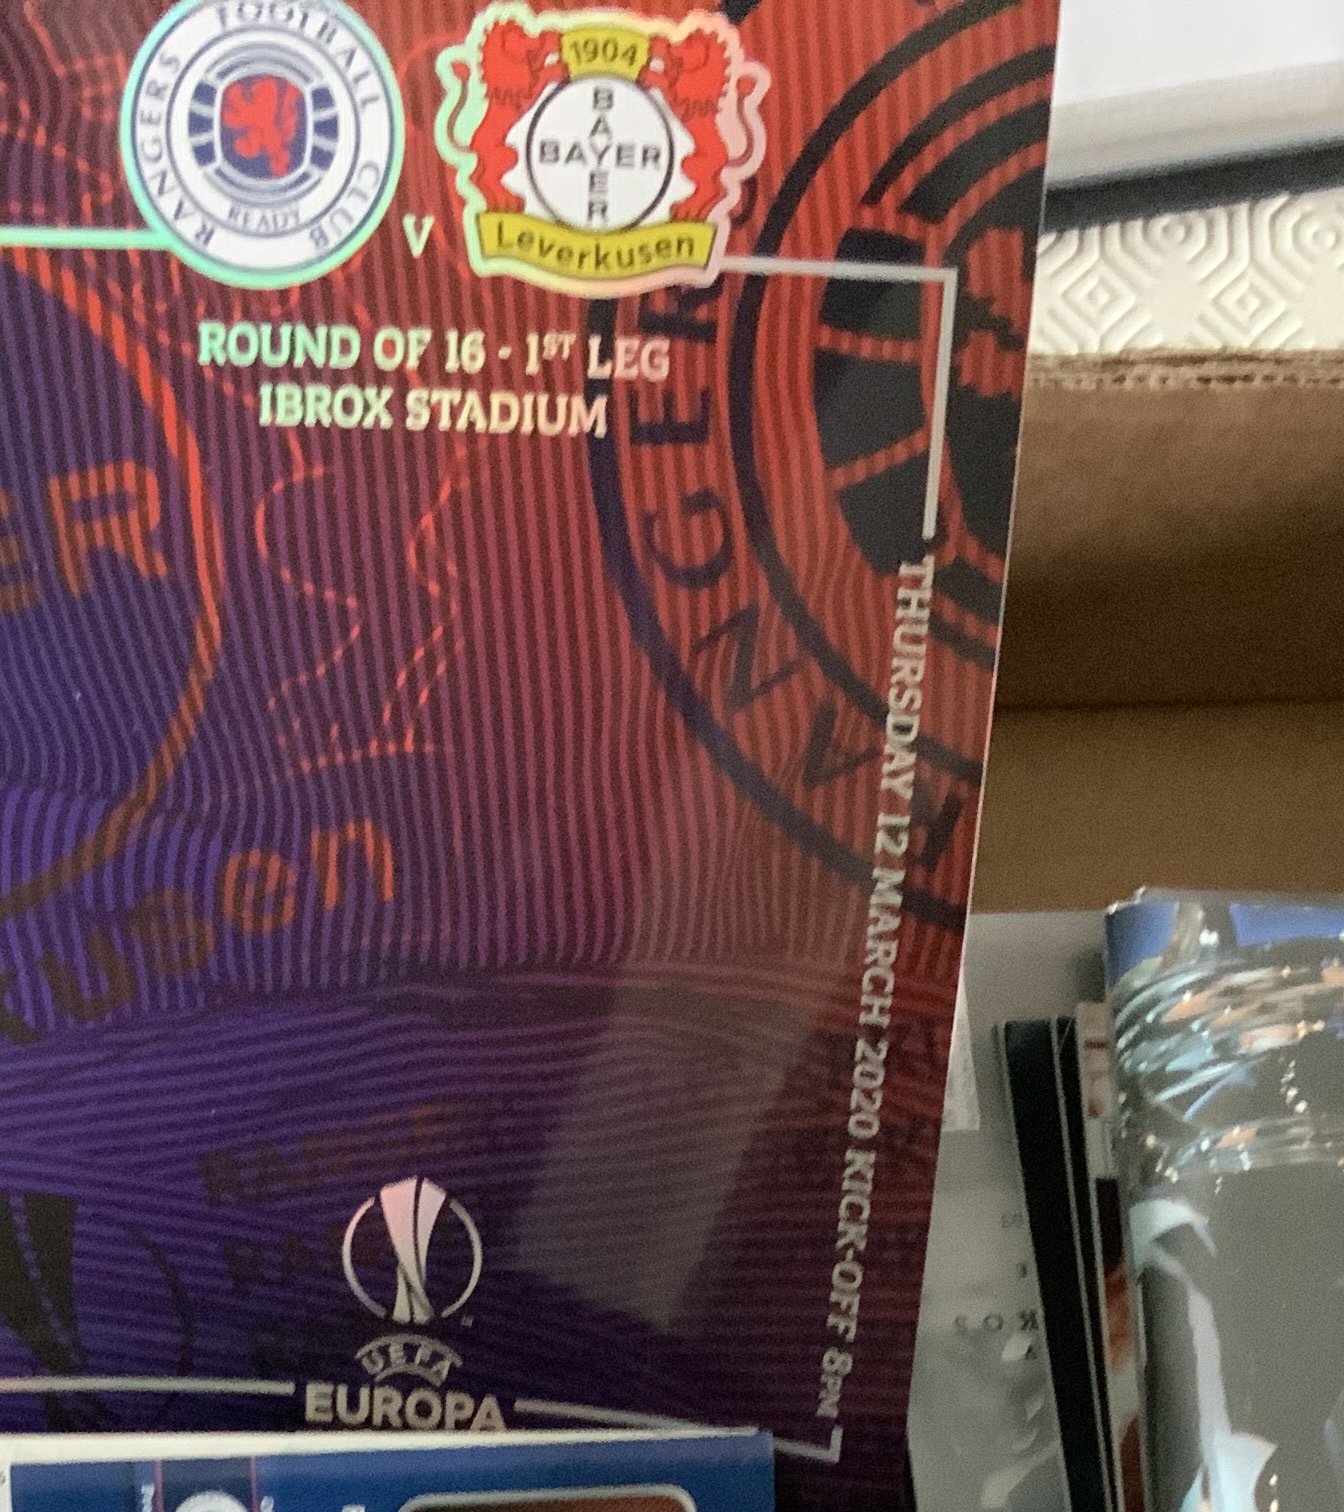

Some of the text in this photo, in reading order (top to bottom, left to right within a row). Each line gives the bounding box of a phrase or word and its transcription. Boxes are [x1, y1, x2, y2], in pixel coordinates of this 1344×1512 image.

[568, 37, 640, 67] 1904
[139, 51, 215, 248] RANGERS
[539, 139, 661, 170] BAYER
[588, 86, 614, 228] BAYER
[228, 204, 303, 230] READY
[309, 161, 381, 248] CLUB
[496, 221, 696, 272] Leverkusen
[198, 320, 359, 369] ROUND
[372, 331, 433, 372] OF
[444, 329, 486, 369] 16
[587, 336, 670, 382] LEG
[258, 381, 608, 439] IBROX STADIUM
[879, 553, 936, 803] THURSDAY
[873, 810, 911, 857] 12
[858, 865, 907, 1030] MARCH
[847, 1036, 890, 1141] 2020
[825, 1148, 878, 1342] KICK-OFF
[359, 1340, 458, 1385] UEFA
[304, 1382, 508, 1433] EUROPA
